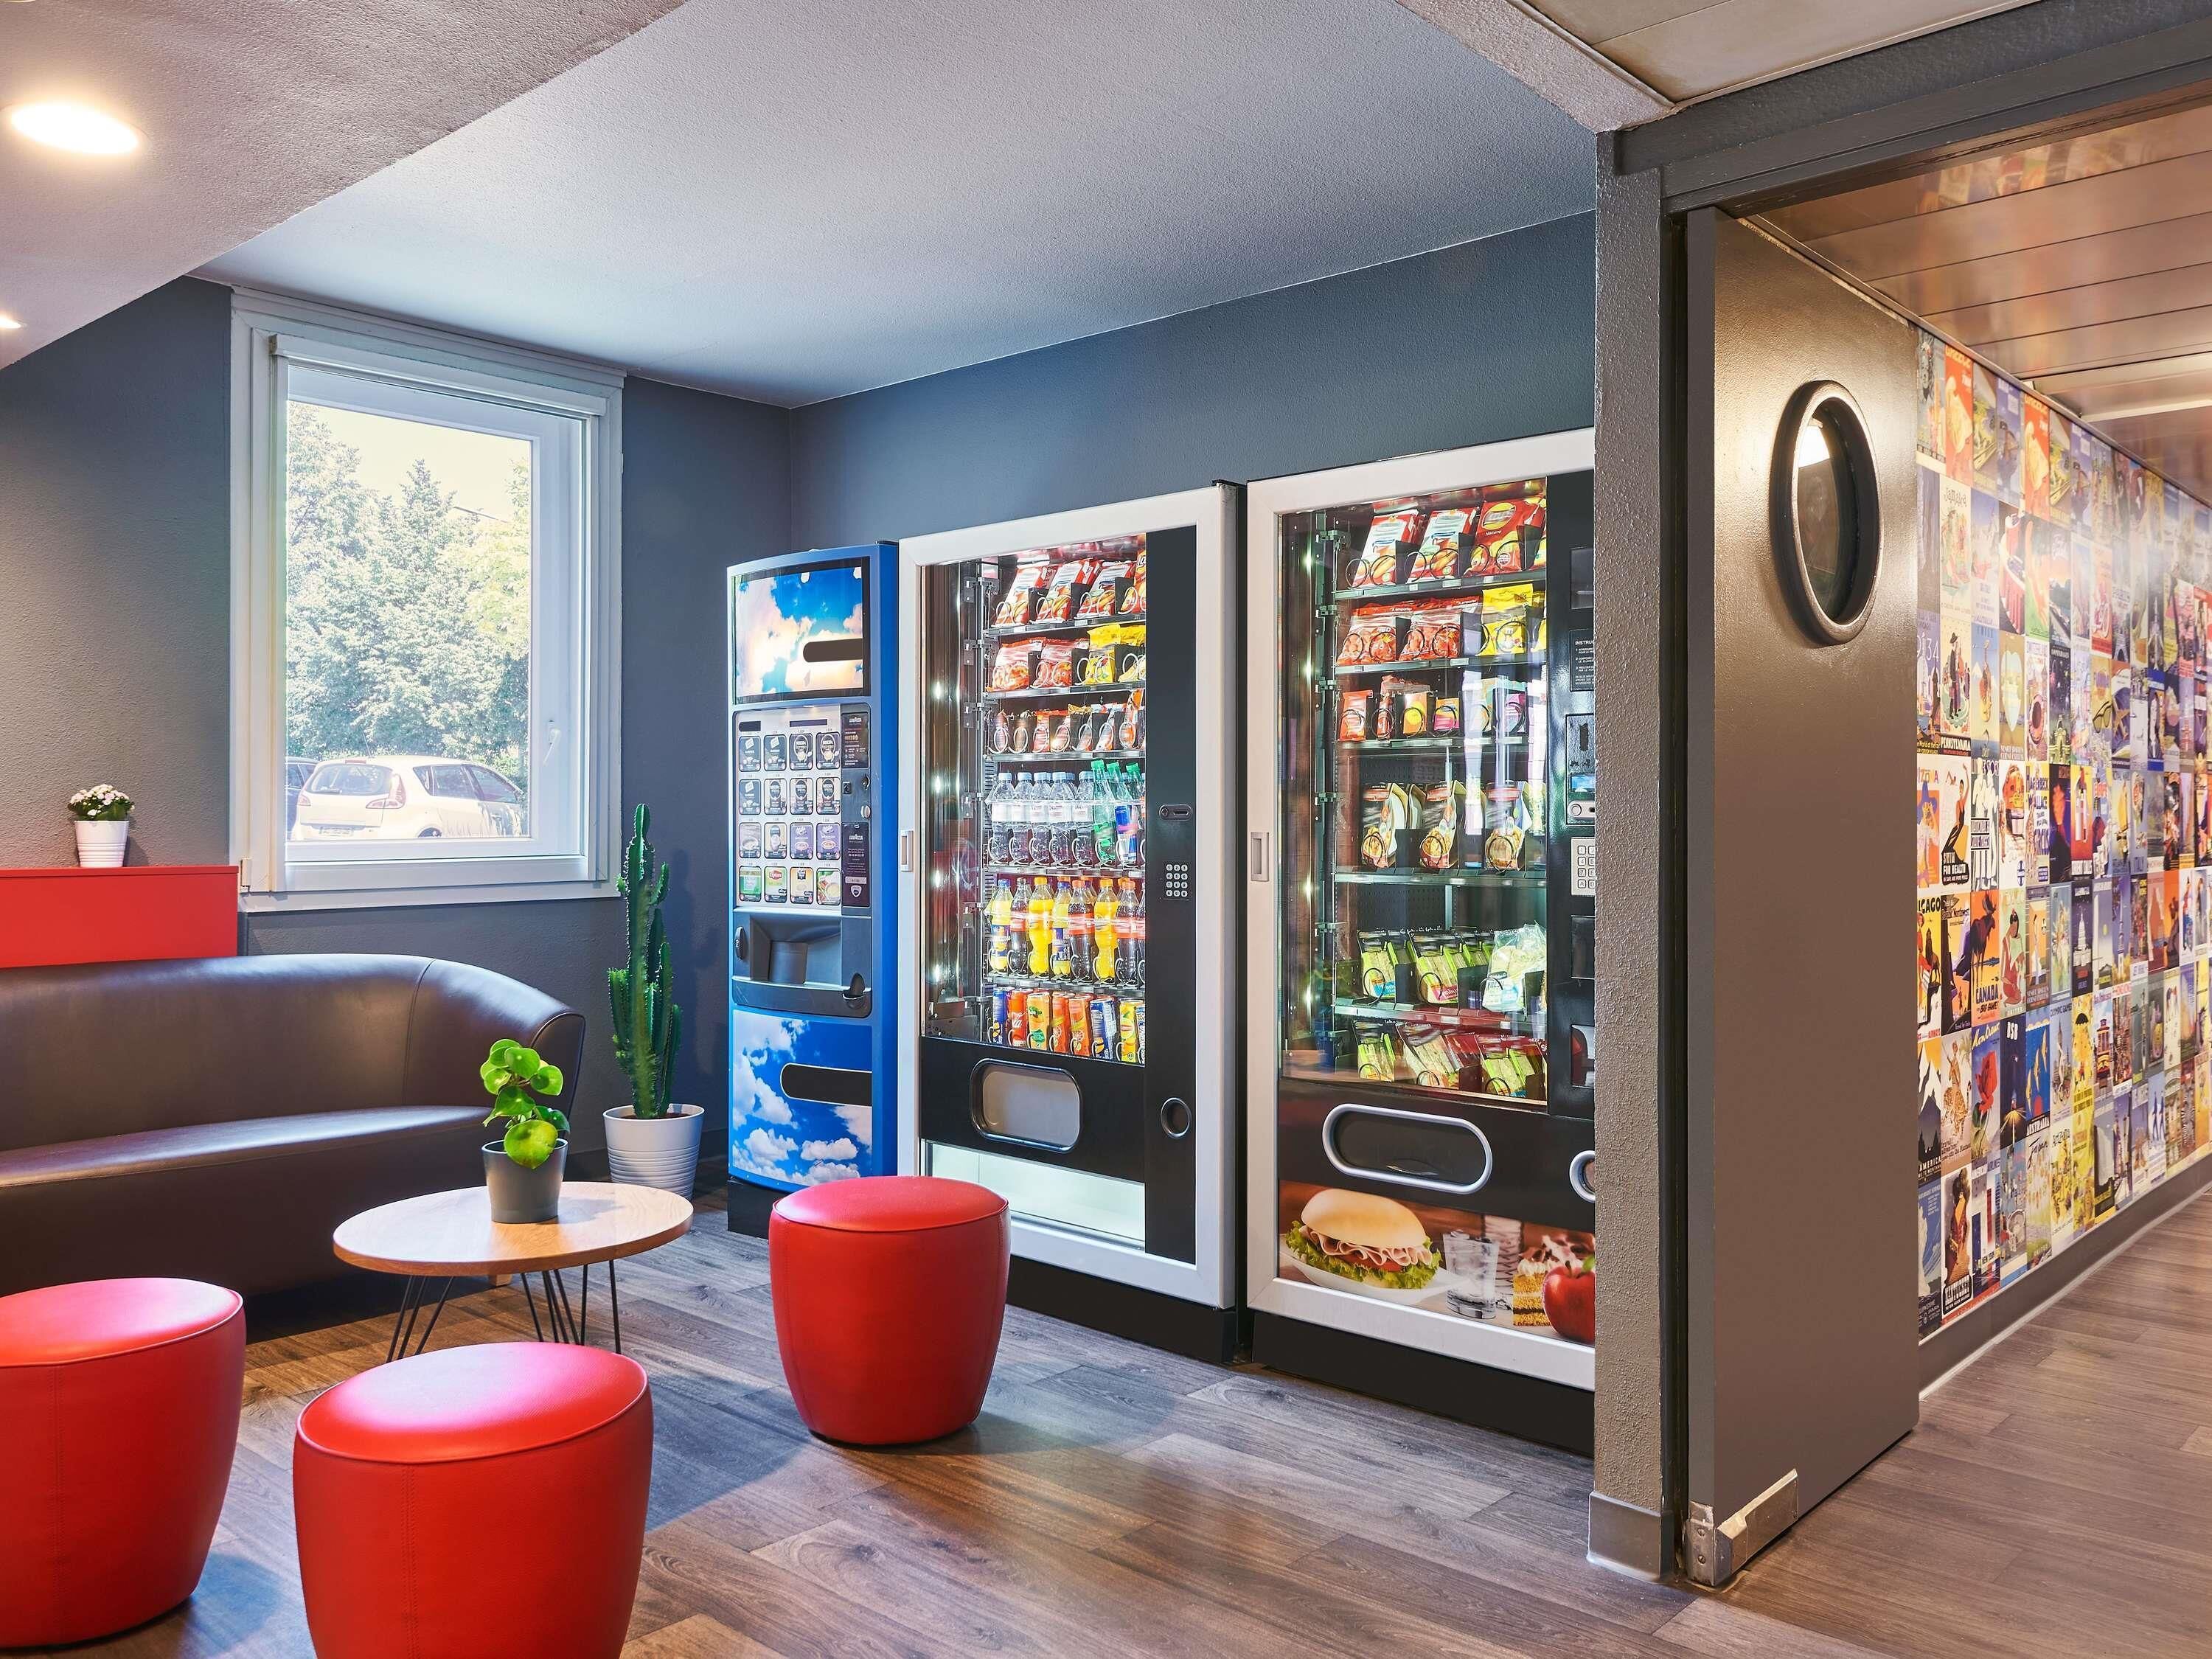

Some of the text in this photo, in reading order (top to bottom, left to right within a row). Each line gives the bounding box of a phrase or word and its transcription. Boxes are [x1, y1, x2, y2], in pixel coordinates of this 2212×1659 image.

[1976, 984, 1999, 1004] CANADA
[2027, 1117, 2049, 1135] AUSTRALIA
[1919, 1156, 1941, 1172] AMERICA
